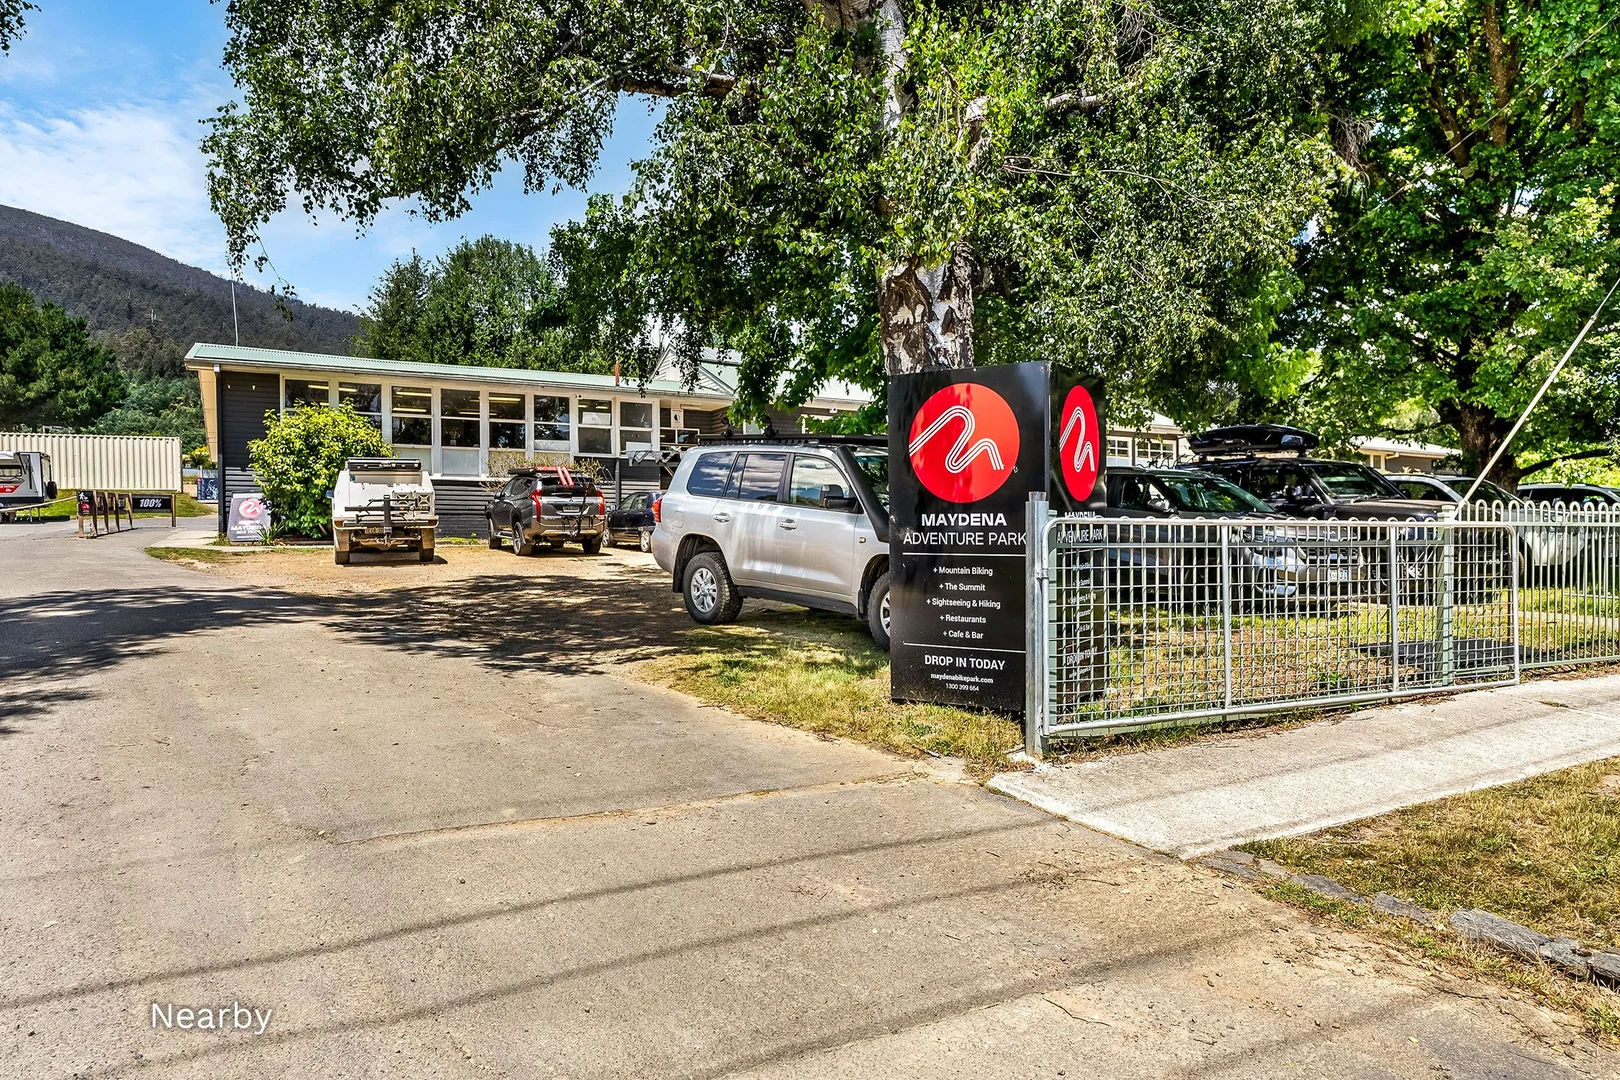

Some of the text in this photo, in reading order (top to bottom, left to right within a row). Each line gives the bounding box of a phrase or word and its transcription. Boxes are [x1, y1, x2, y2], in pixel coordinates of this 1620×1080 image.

[140, 499, 162, 508] 100%
[921, 513, 1008, 527] MAYDENA
[903, 532, 1027, 546] ADVENTURE PARK
[1090, 528, 1103, 540] ARK
[938, 566, 971, 574] Mountain
[971, 567, 994, 577] Biking
[958, 583, 986, 591] Summit
[931, 598, 971, 609] Sightseeing
[978, 600, 1001, 610] Hiking
[945, 614, 987, 624] Restaurants
[948, 630, 964, 638] Cafe
[965, 631, 970, 639] &
[971, 631, 984, 639] Bar
[924, 655, 1006, 670] DROP IN TODAY
[930, 673, 994, 684] maydenabikepark.com
